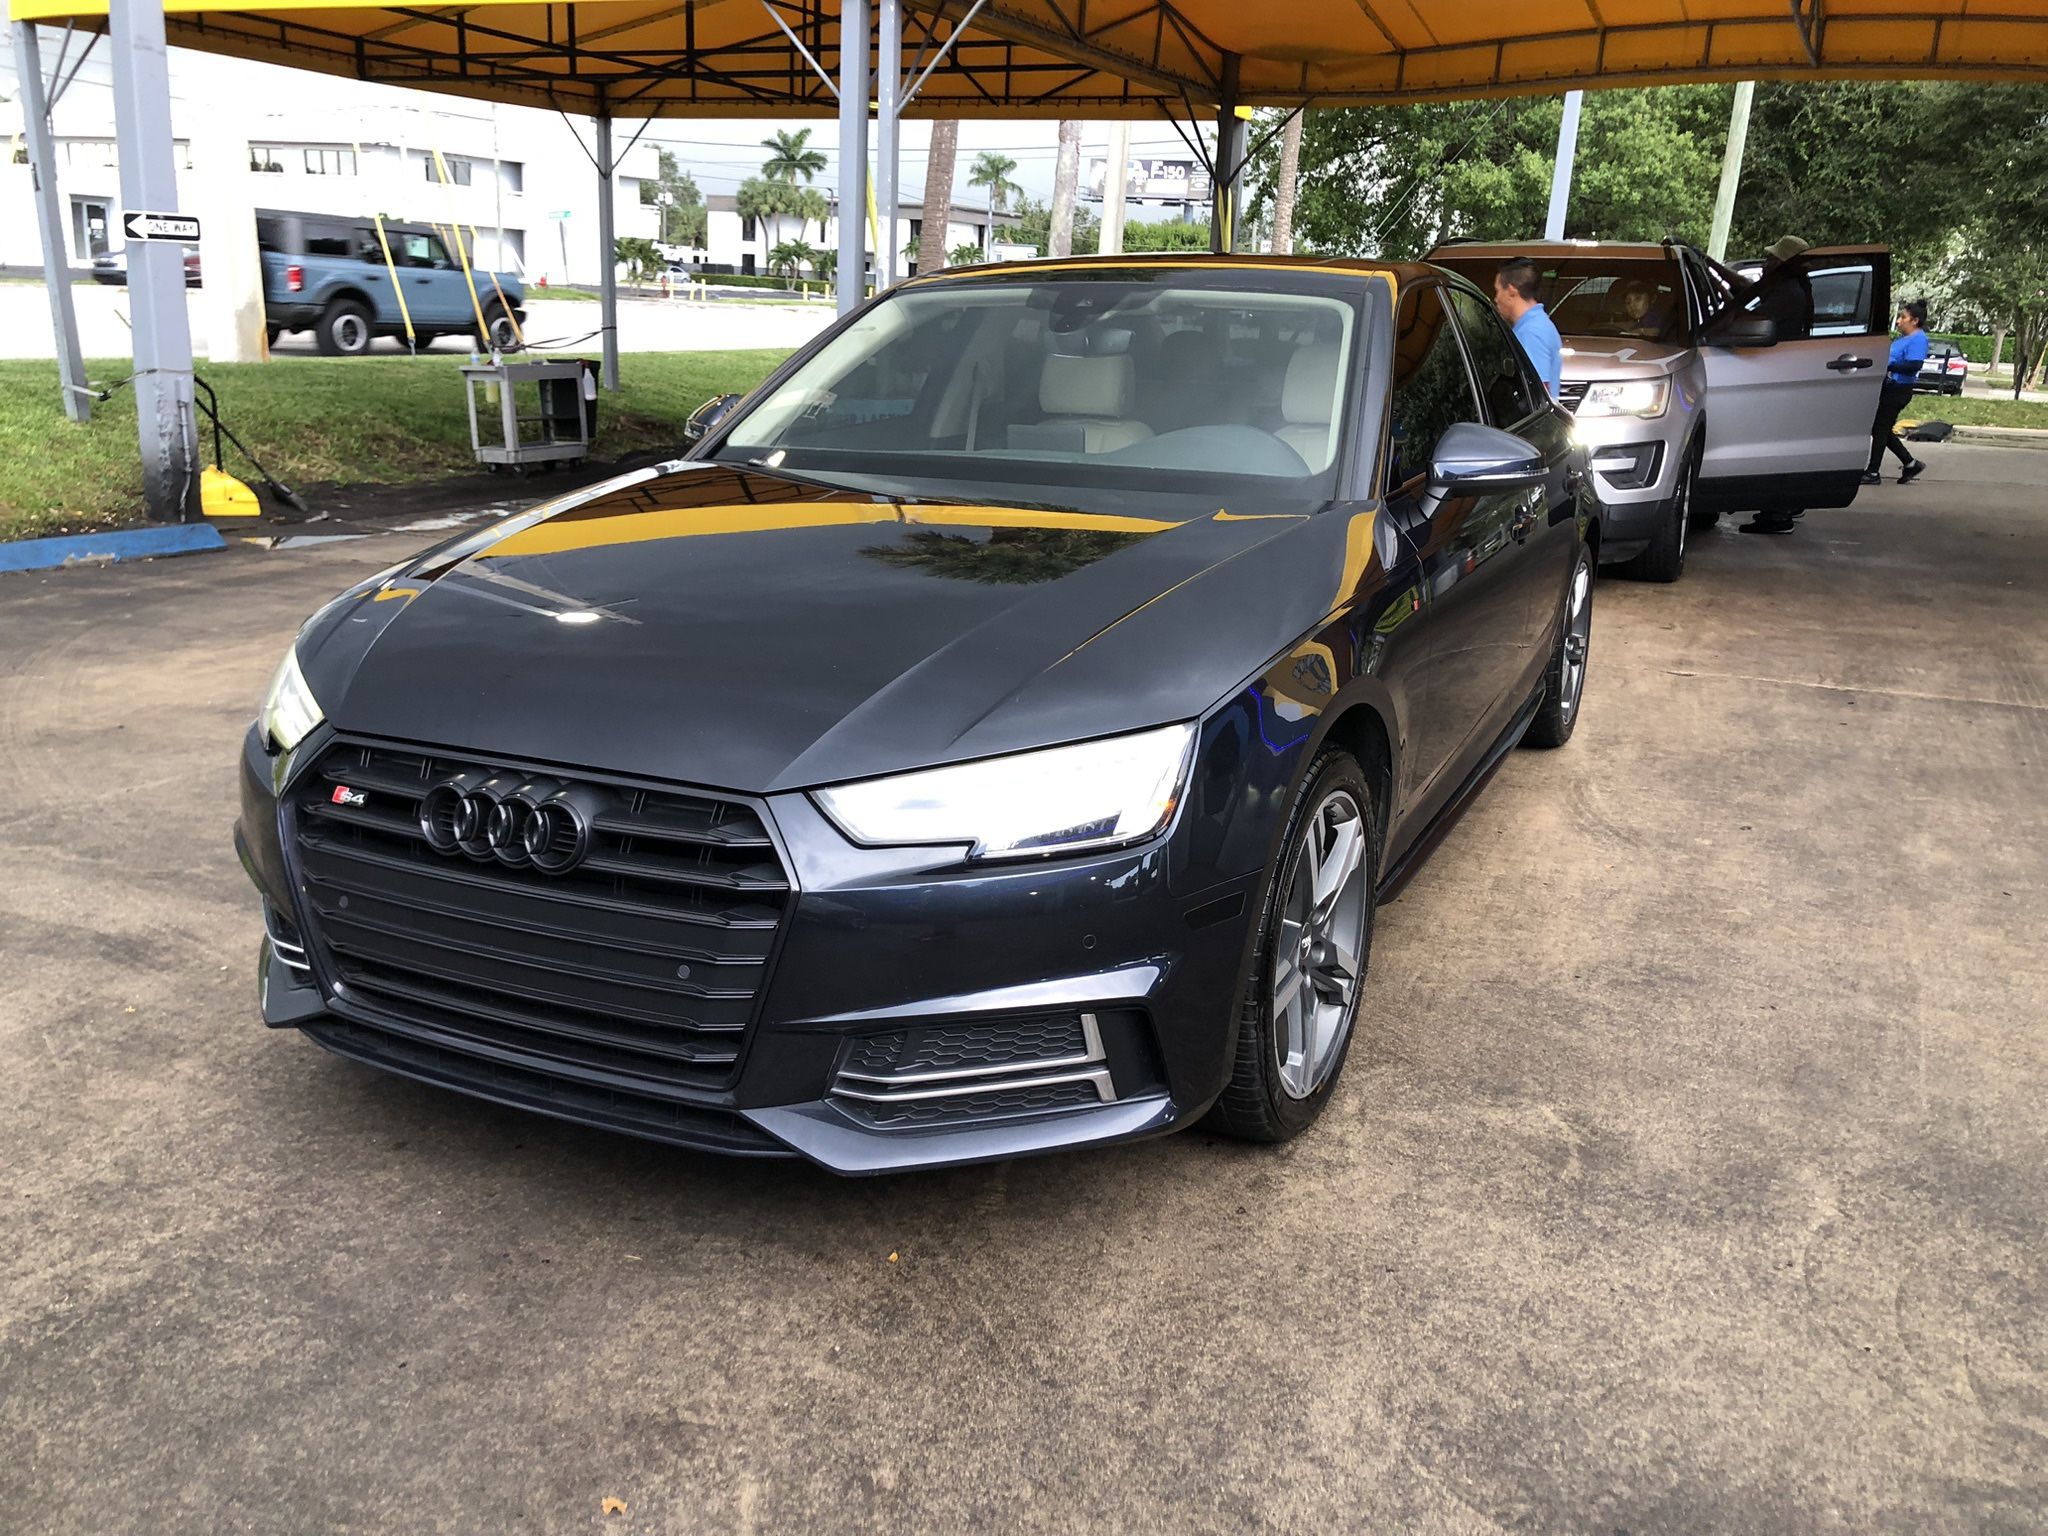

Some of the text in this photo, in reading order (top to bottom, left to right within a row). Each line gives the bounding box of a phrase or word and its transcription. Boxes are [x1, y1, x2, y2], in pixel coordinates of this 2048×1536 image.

[1150, 164, 1185, 180] F-150
[148, 221, 194, 233] ONE WAY
[339, 790, 365, 806] S4
